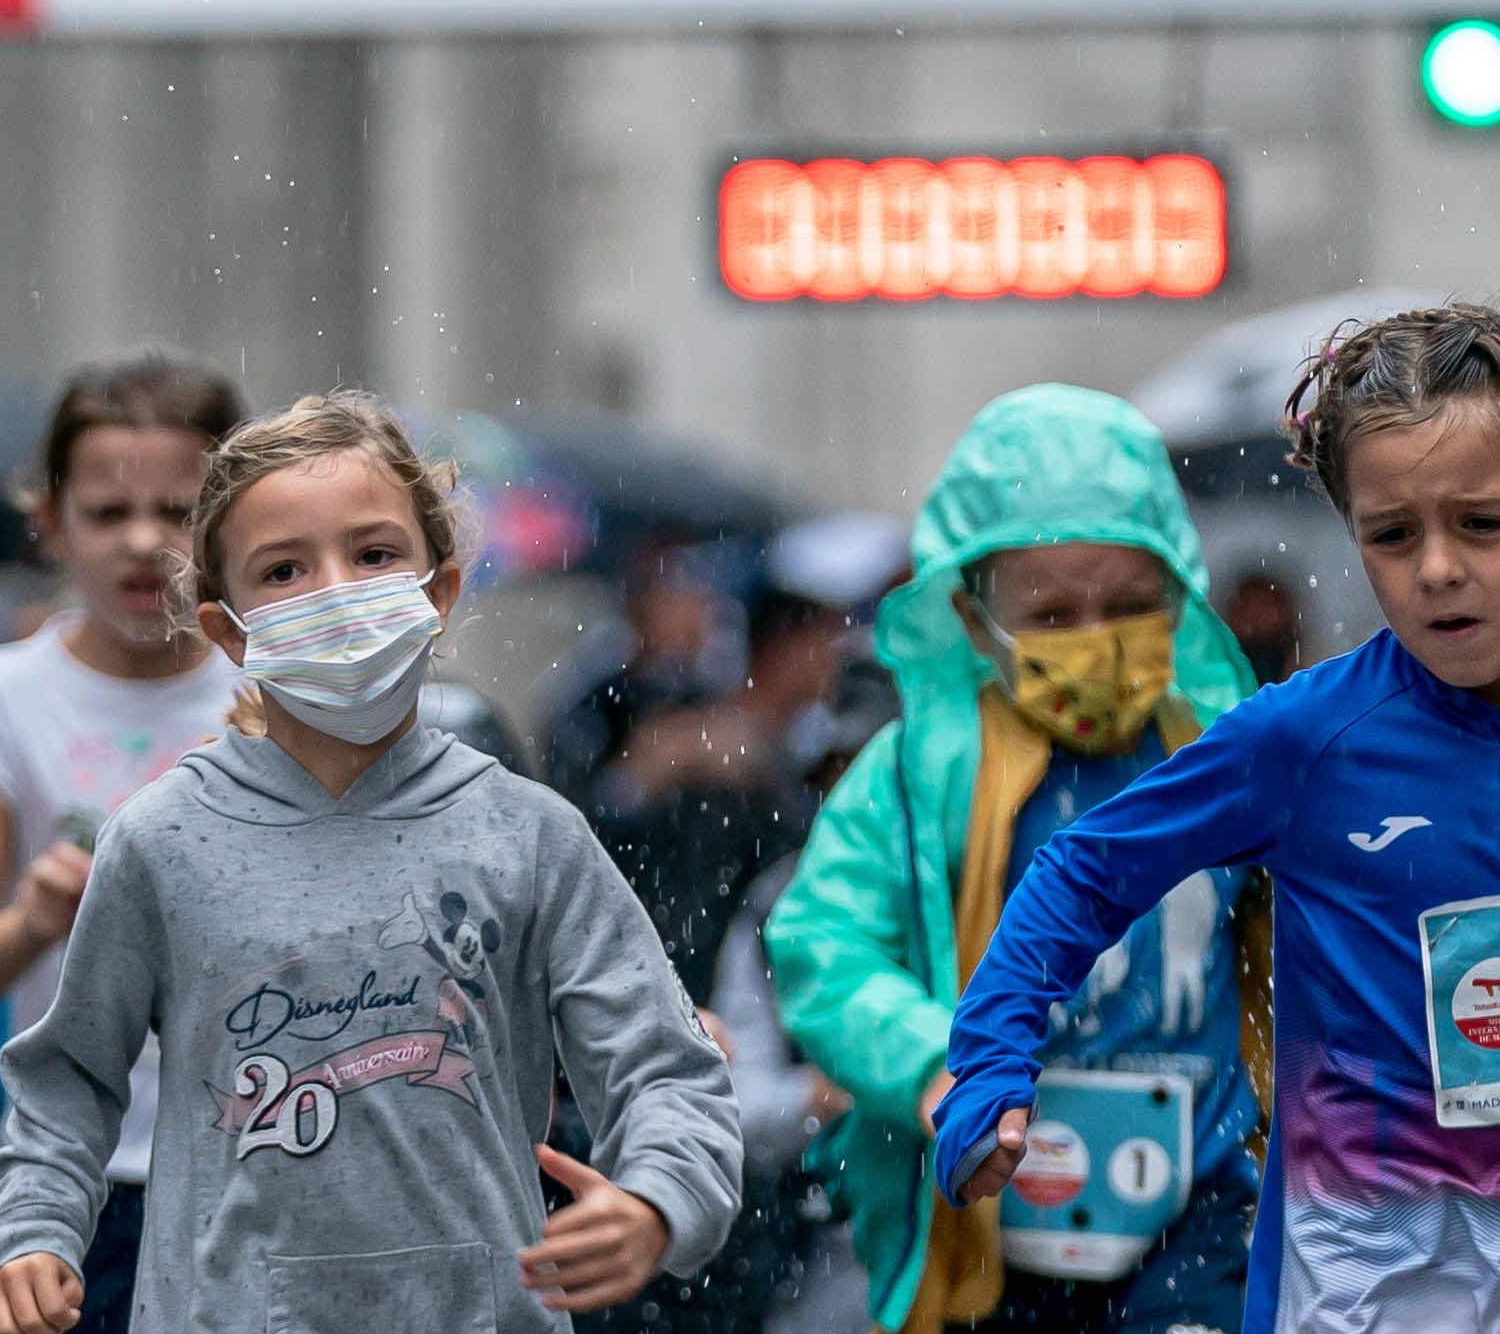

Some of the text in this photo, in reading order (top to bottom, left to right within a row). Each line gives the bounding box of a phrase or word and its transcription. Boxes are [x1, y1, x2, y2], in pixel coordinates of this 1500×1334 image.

[226, 970, 421, 1051] Disneyland
[233, 1052, 340, 1161] 20
[1133, 1147, 1146, 1190] 1
